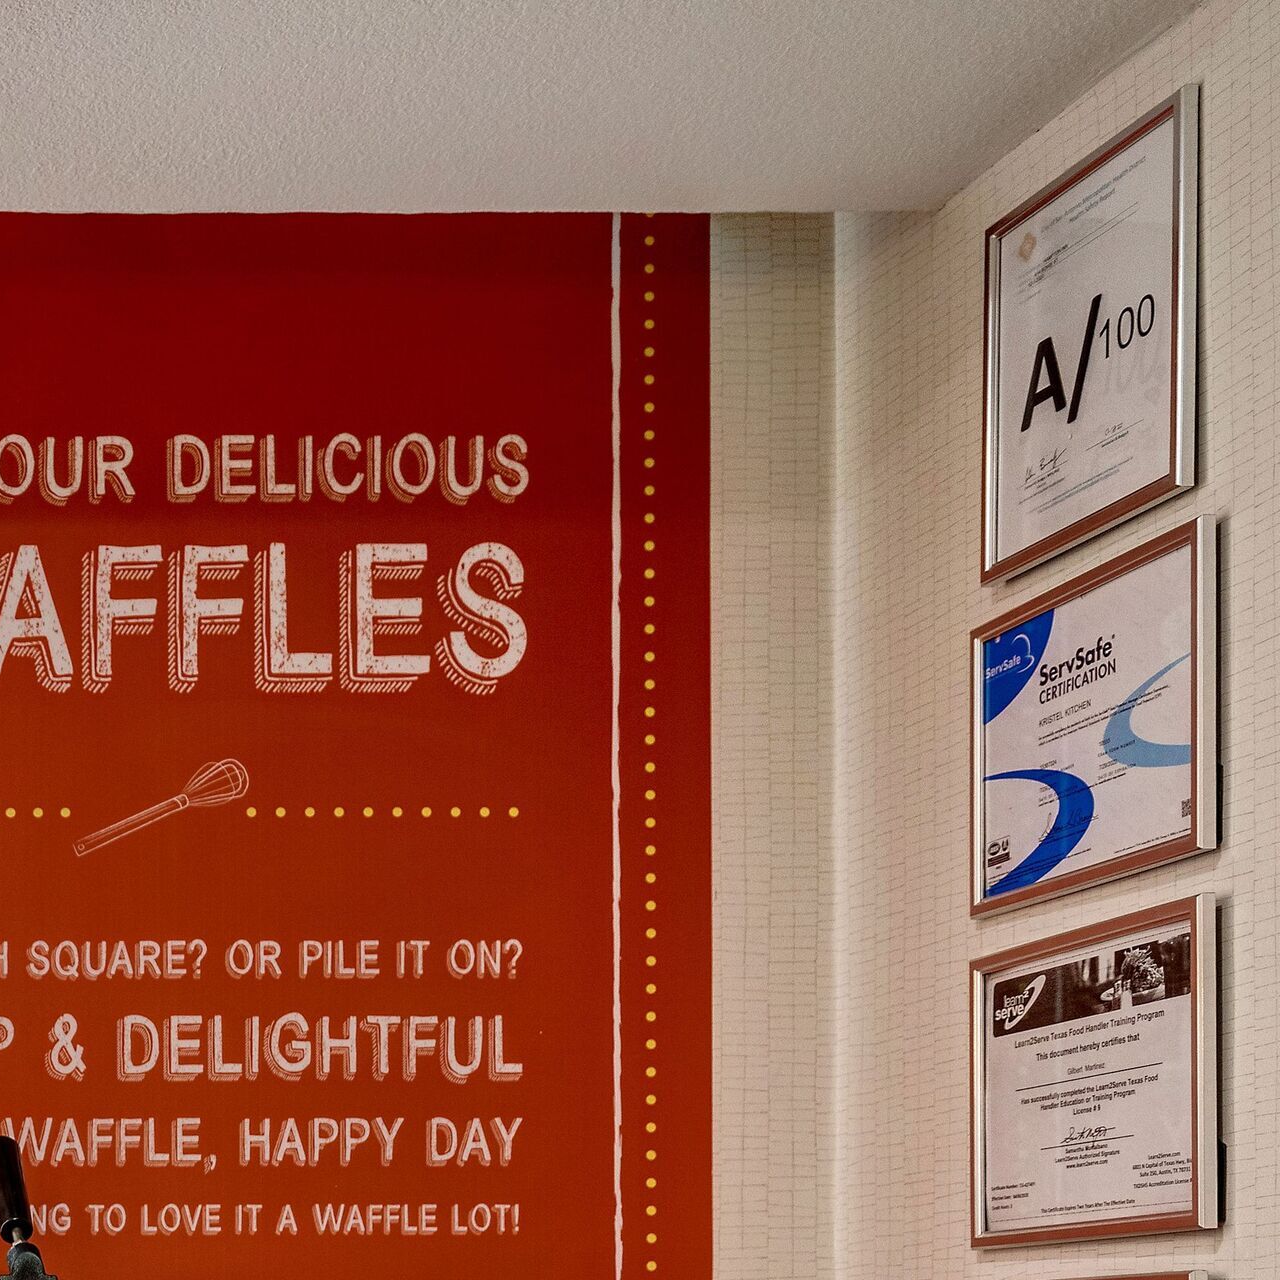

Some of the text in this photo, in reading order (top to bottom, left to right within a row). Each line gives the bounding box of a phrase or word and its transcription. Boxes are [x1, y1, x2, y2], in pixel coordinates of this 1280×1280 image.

[167, 432, 530, 505] DELICIOUS
[985, 655, 1021, 679] ServSafe
[1039, 658, 1117, 704] CERTIFICATION
[1038, 712, 1064, 727] KRISTEL
[26, 939, 208, 981] SQUARE?
[225, 939, 283, 980] OR
[299, 939, 380, 979] PILE
[396, 939, 430, 979] IT
[445, 938, 523, 979] ON?
[995, 1004, 1024, 1020] serve
[1050, 1032, 1067, 1041] Texas
[1069, 1026, 1084, 1036] Food
[1085, 1022, 1109, 1034] Handler
[1110, 1015, 1136, 1027] Training
[1137, 1010, 1165, 1022] Program
[44, 1011, 86, 1080] &
[117, 1012, 524, 1084] DELIGHTFUL
[1036, 1033, 1140, 1061] This document hereby certifies that
[1128, 1077, 1143, 1085] Texas
[1144, 1074, 1159, 1082] Food
[1060, 1097, 1084, 1108] Education
[1092, 1092, 1112, 1102] Training
[1113, 1089, 1136, 1099] Program
[0, 1116, 218, 1174] WAFFLE,
[239, 1117, 405, 1167] HAPPY
[425, 1117, 522, 1167] DAY
[85, 1203, 128, 1236] TO
[140, 1203, 223, 1235] LOVE
[234, 1203, 264, 1235] IT
[276, 1203, 298, 1235] A
[311, 1203, 438, 1236] WAFFLE
[452, 1203, 522, 1236] LOT!
